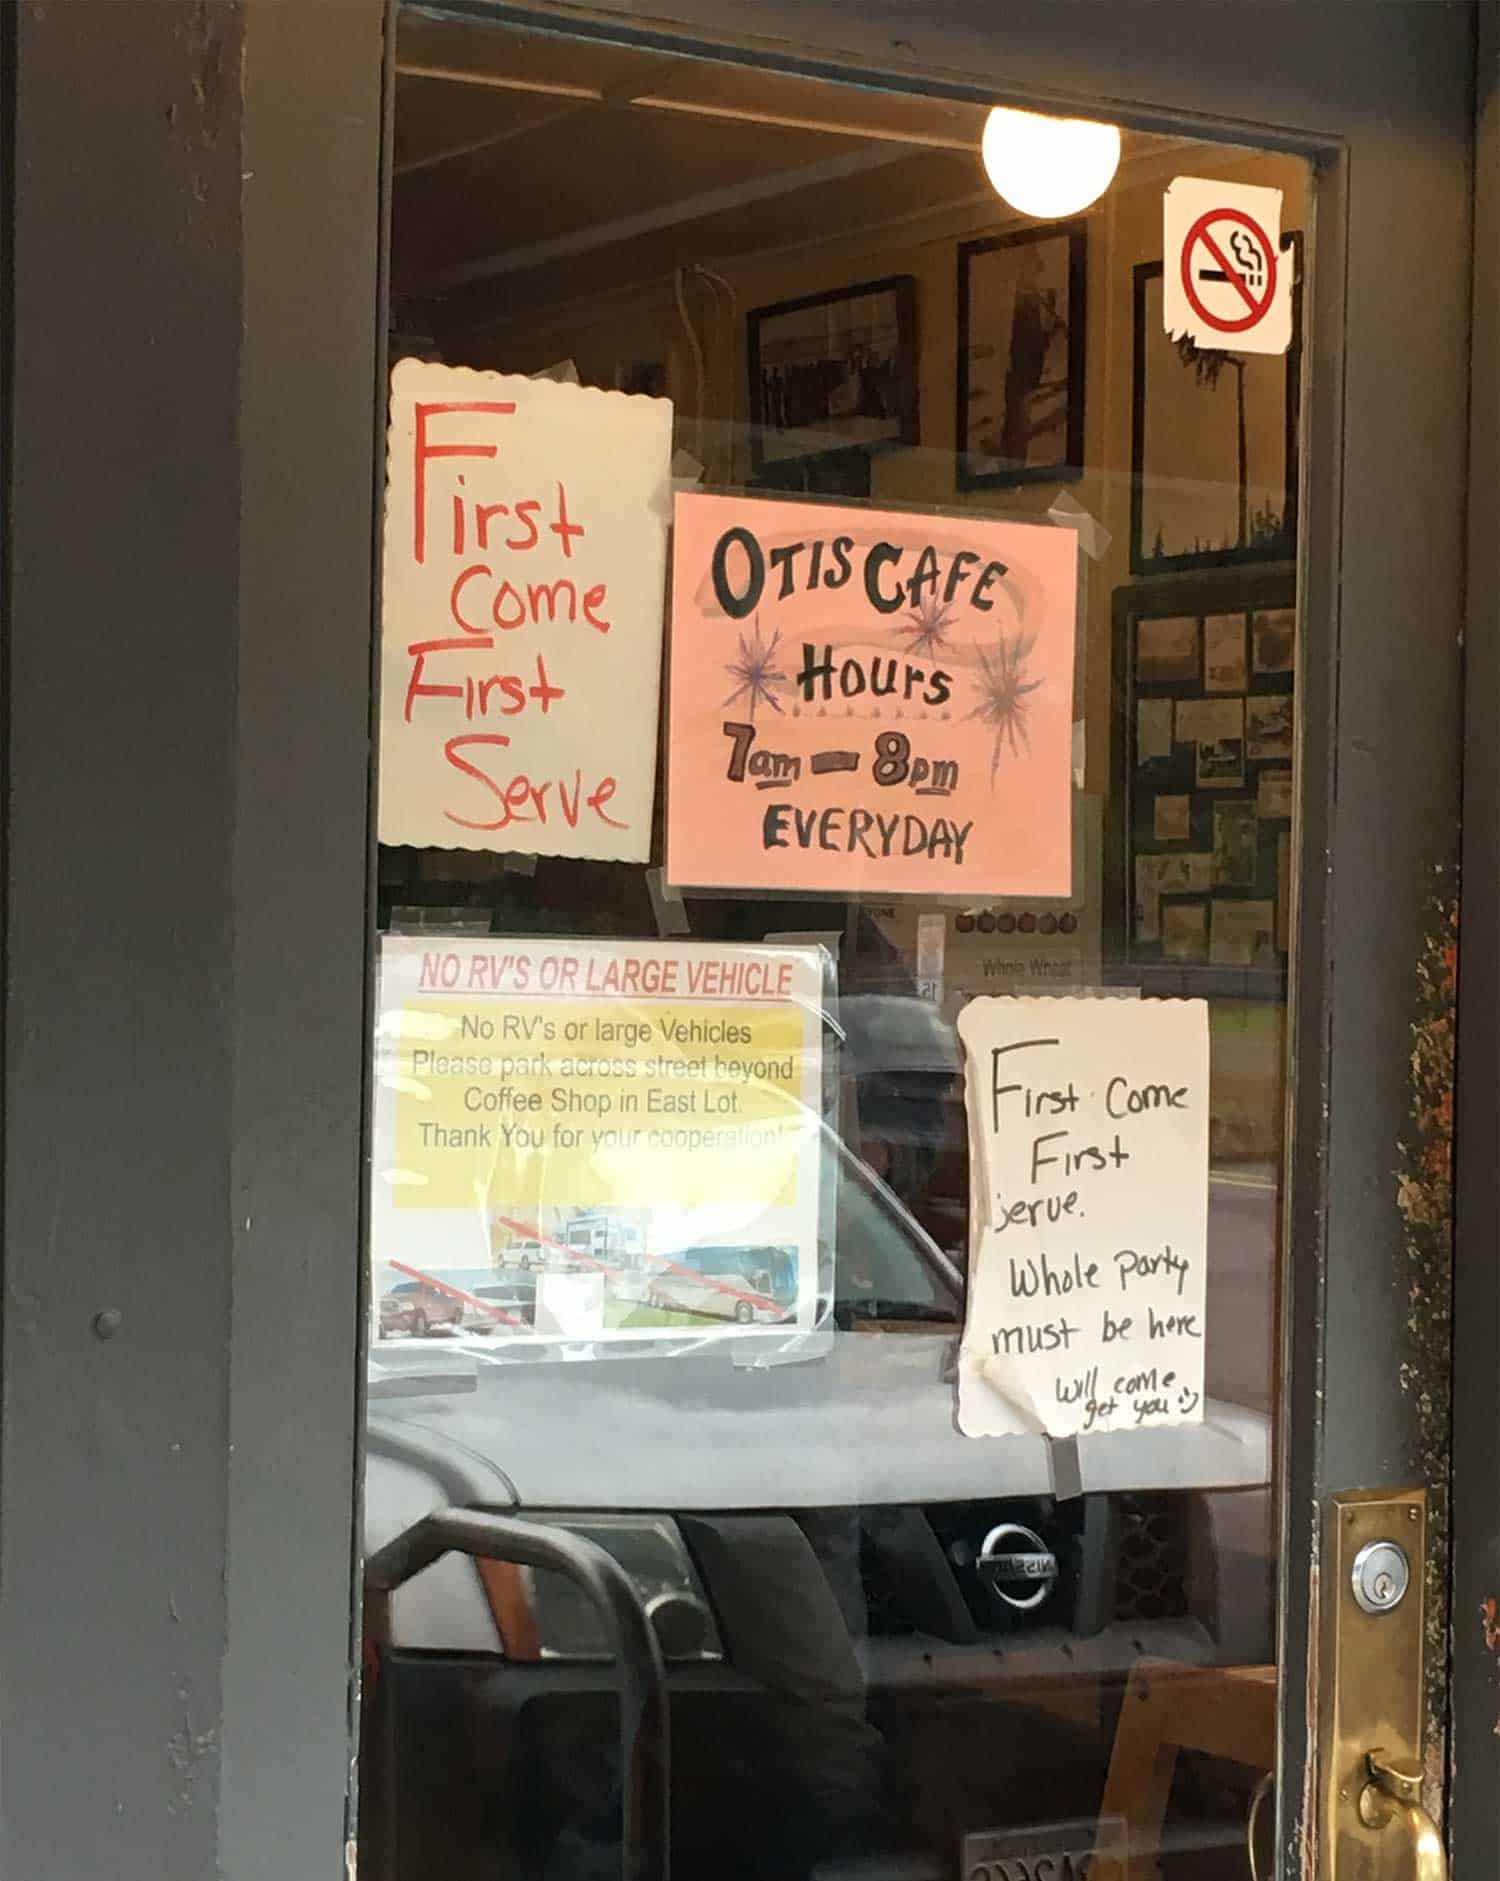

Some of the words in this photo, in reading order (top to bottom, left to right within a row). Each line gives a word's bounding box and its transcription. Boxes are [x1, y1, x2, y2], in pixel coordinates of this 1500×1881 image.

[414, 402, 585, 564] First
[451, 564, 611, 634] Come
[712, 526, 855, 619] OTIS
[864, 542, 1009, 614] CAFE
[405, 637, 565, 724] First
[797, 643, 953, 705] Hours
[444, 733, 629, 830] Serve
[723, 721, 800, 783] 7am
[872, 731, 959, 788] 8pm
[763, 804, 974, 864] EVERYDAY
[419, 952, 460, 987] NO
[468, 954, 529, 988] RV'S
[539, 956, 578, 990] OR
[587, 959, 678, 993] LARGE
[686, 960, 792, 996] VEHICLE
[460, 1014, 494, 1040] No
[502, 1016, 556, 1040] RV's
[564, 1022, 587, 1041] or
[595, 1017, 652, 1048] large
[660, 1018, 751, 1044] Vehicles
[412, 1050, 492, 1076] Please
[501, 1052, 553, 1081] park
[561, 1060, 637, 1078] across
[645, 1056, 707, 1078] street
[714, 1057, 794, 1084] beyond
[991, 1038, 1080, 1132] First
[464, 1087, 542, 1112] Coffee
[551, 1089, 611, 1118] Shop
[620, 1089, 639, 1112] in
[647, 1090, 696, 1113] East
[419, 1123, 491, 1148] Thank
[500, 1123, 545, 1148] You
[553, 1124, 582, 1148] for
[592, 1130, 640, 1155] your
[1031, 1130, 1129, 1184] First
[991, 1317, 1081, 1355] must
[1102, 1310, 1132, 1342] be
[1148, 1308, 1201, 1339] here
[1084, 1399, 1118, 1429] get
[1133, 1397, 1170, 1425] you
